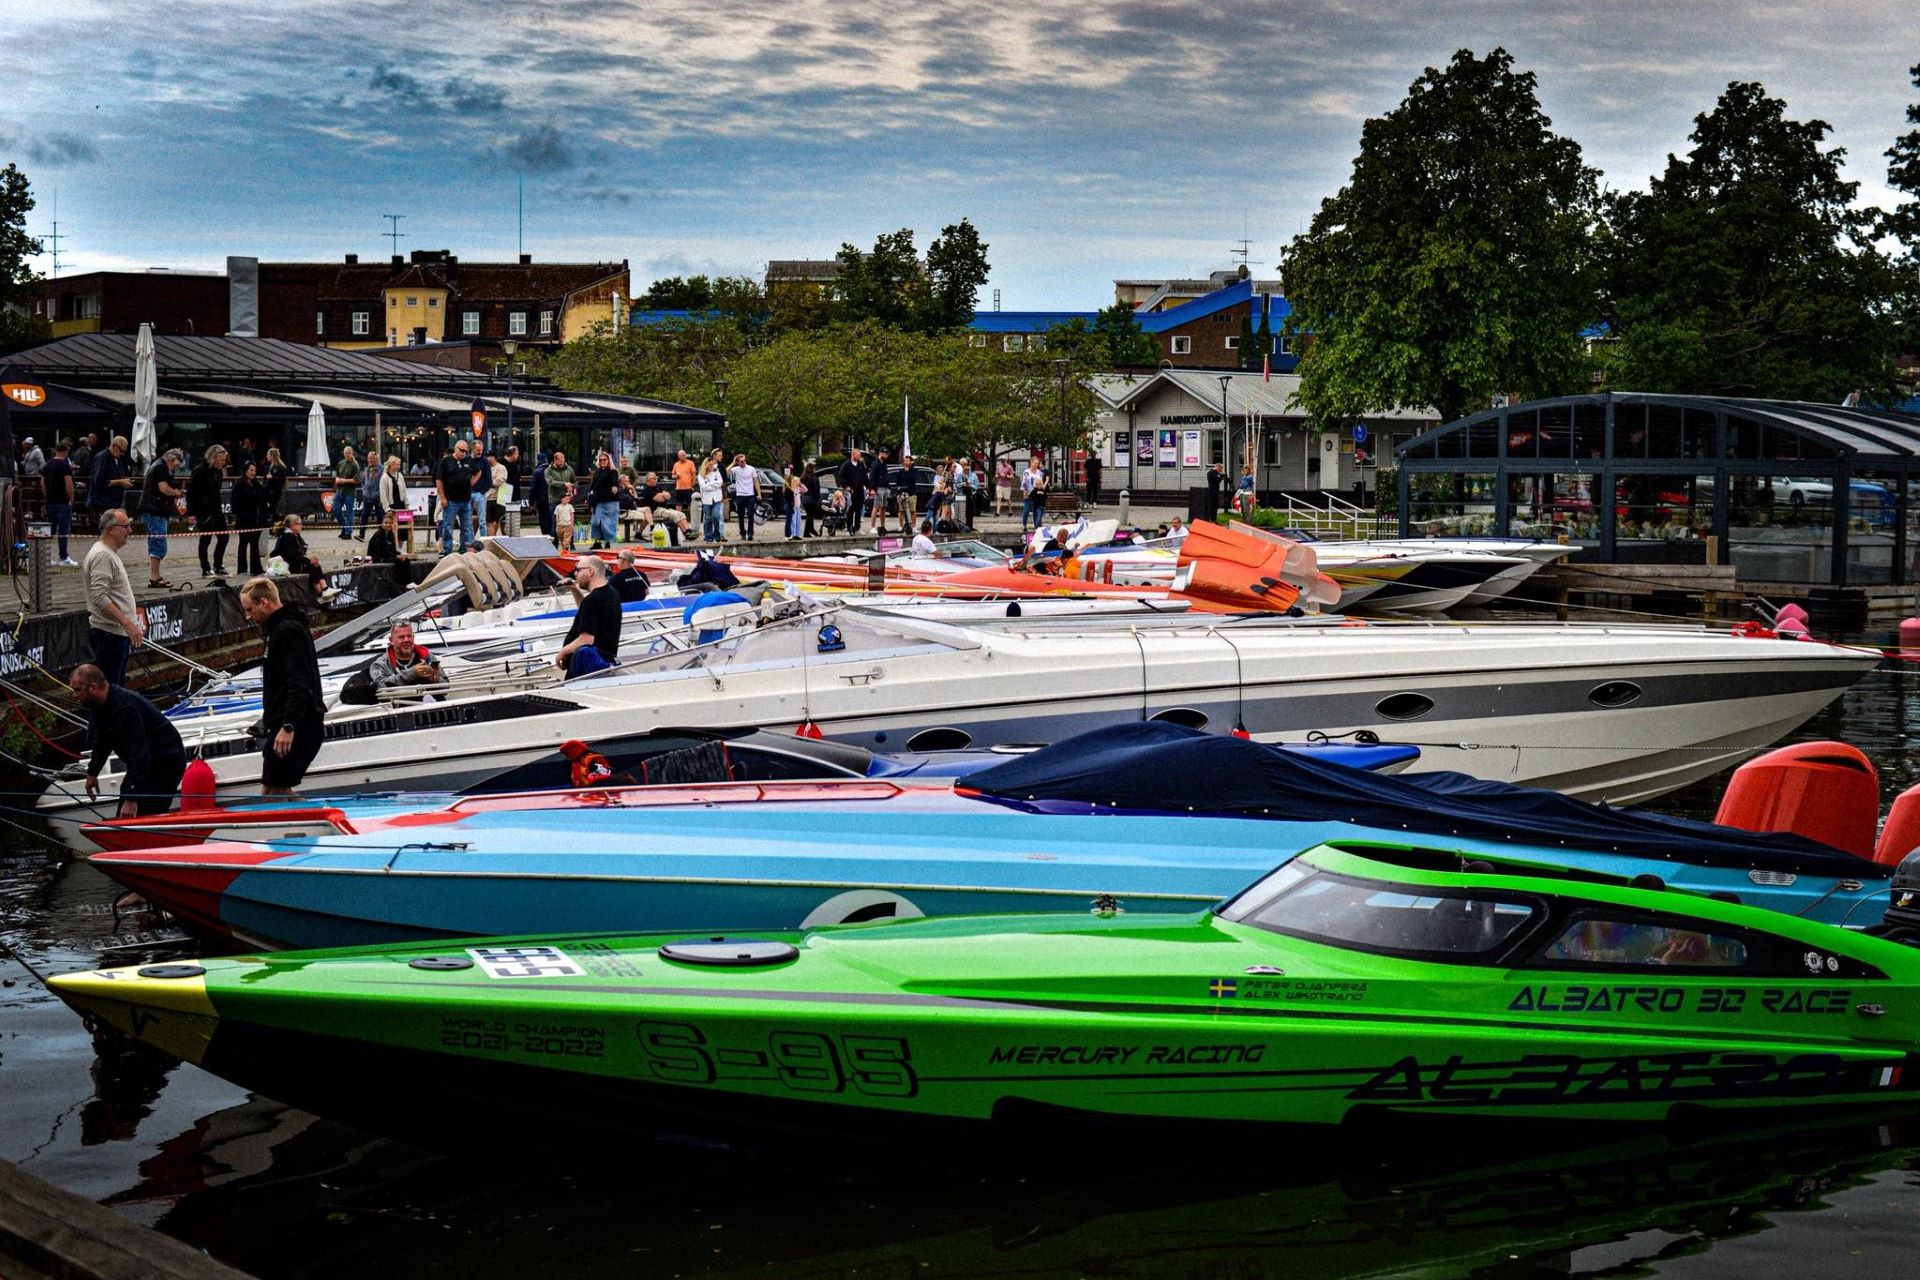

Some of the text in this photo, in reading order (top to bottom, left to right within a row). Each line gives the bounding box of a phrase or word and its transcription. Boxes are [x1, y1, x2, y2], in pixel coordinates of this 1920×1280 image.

[1243, 991, 1280, 999] ALEX
[1244, 980, 1290, 990] PETER
[1507, 985, 1853, 1014] ALBATRO 32 RACE
[441, 1016, 605, 1040] WORLD CHAMPION
[441, 1029, 605, 1058] 2021-2022
[989, 1043, 1266, 1065] MERCURY RACING
[635, 1019, 919, 1098] S-95
